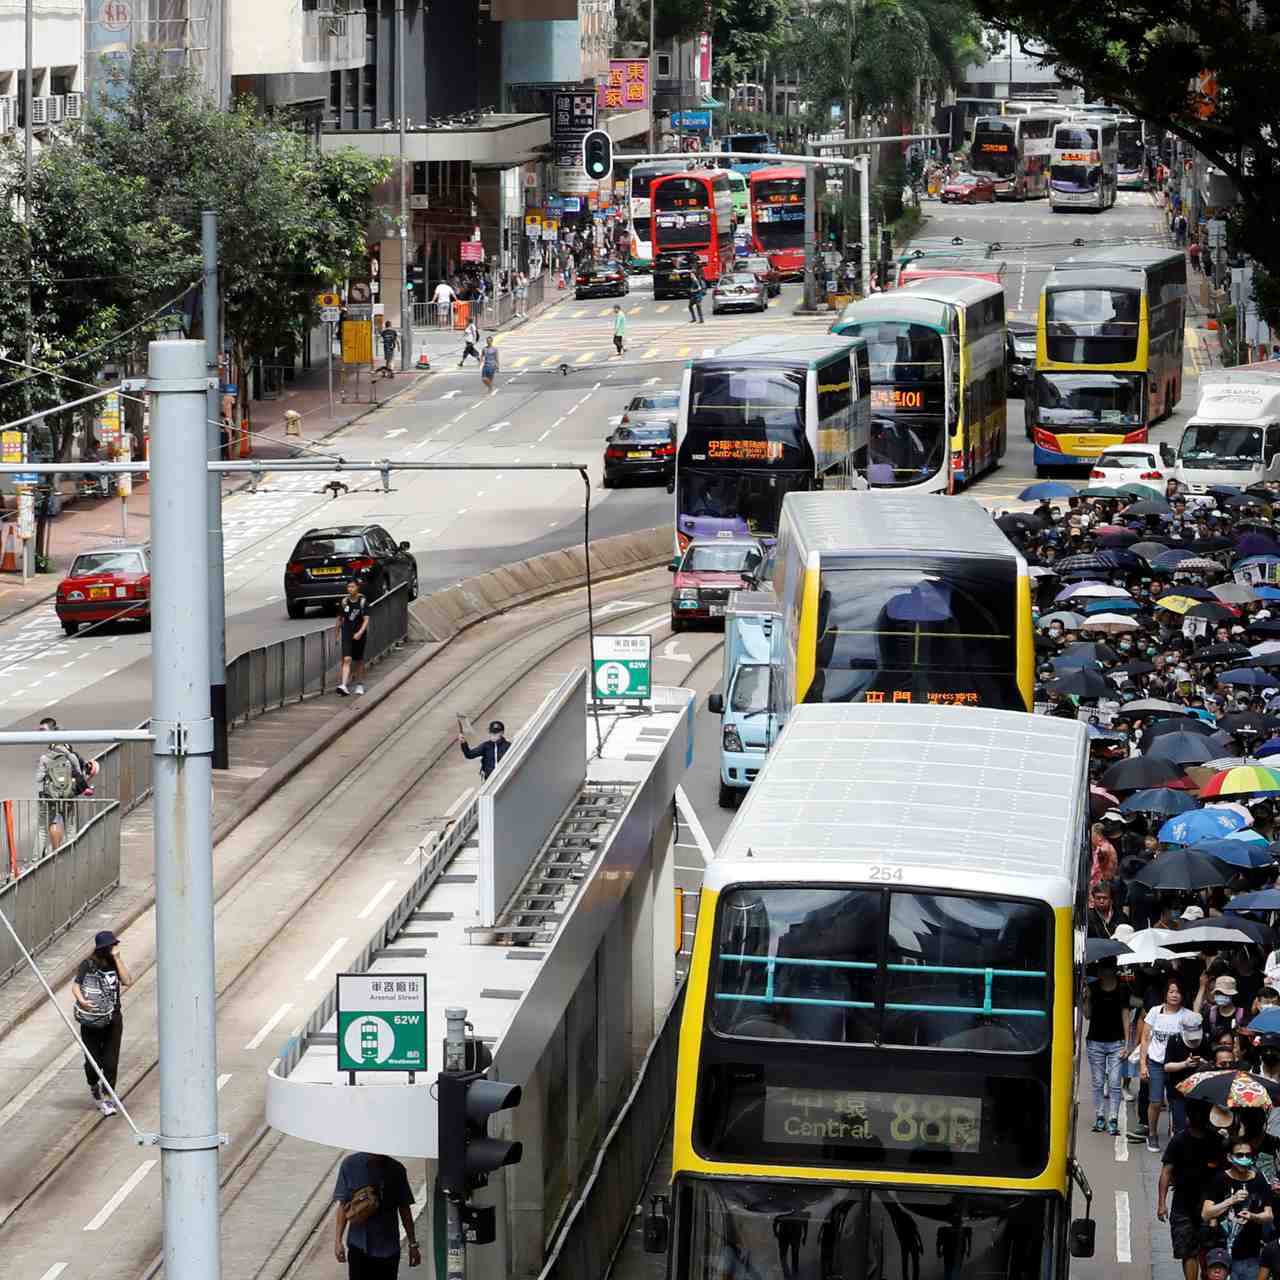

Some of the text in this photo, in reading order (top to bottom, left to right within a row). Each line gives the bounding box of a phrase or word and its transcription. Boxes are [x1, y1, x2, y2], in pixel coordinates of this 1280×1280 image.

[869, 865, 903, 884] 254
[394, 1015, 420, 1025] 62W
[784, 1116, 873, 1140] Central
